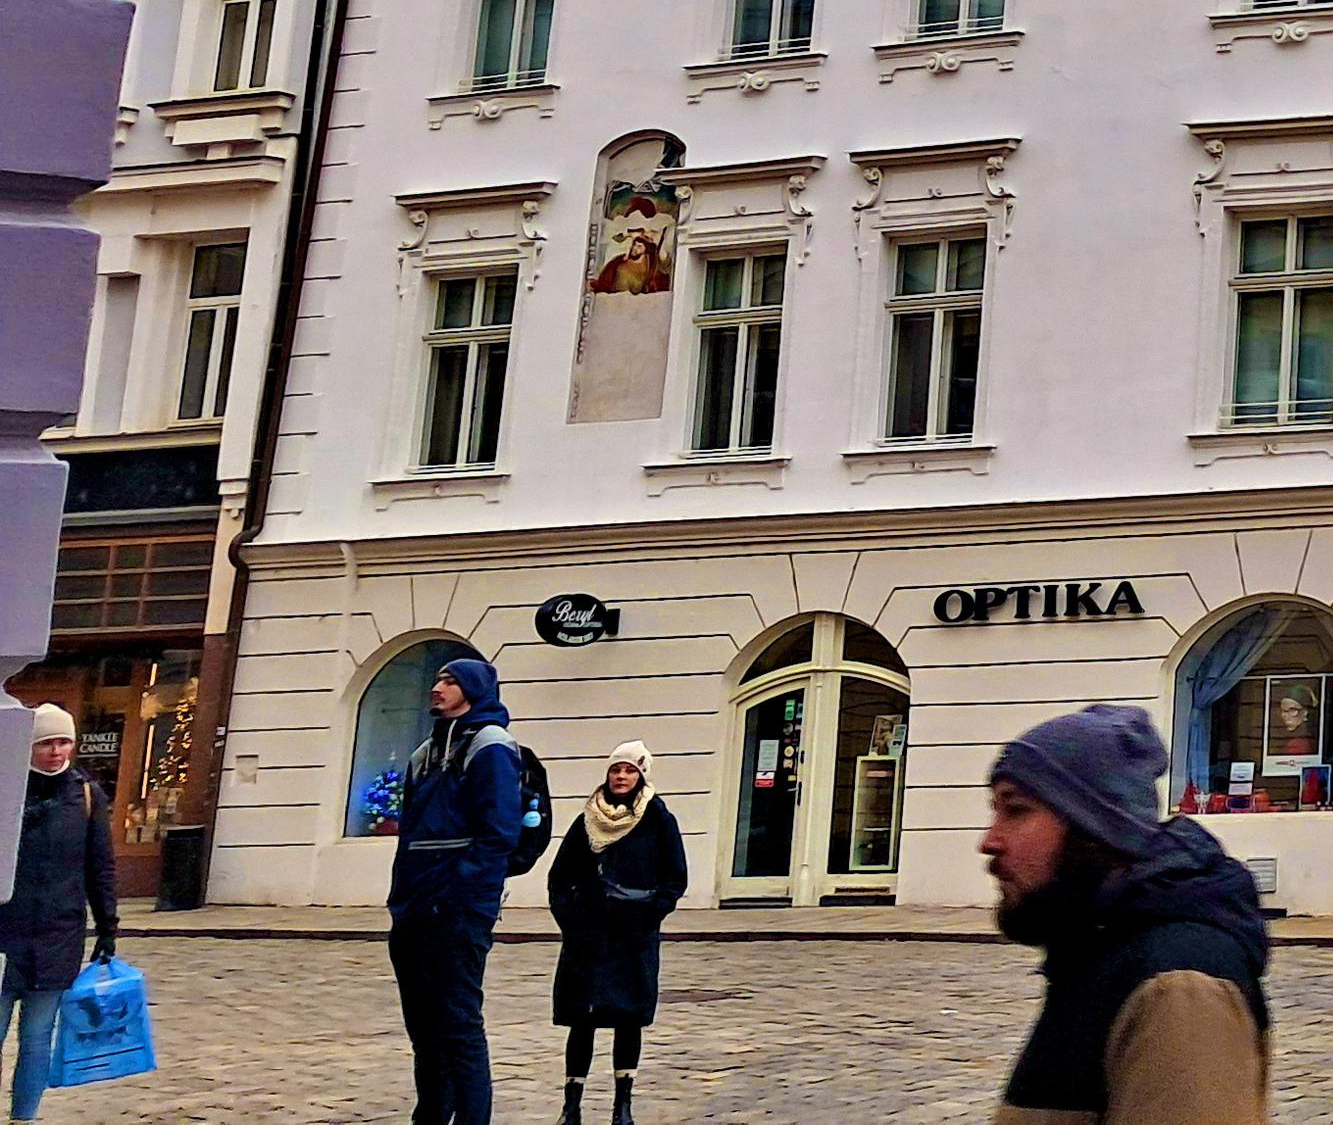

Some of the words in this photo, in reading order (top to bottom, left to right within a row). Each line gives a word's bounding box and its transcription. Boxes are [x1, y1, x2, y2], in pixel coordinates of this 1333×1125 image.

[552, 600, 598, 628] Beryl
[933, 580, 1145, 622] OPTIKA
[79, 742, 119, 753] CANDLE
